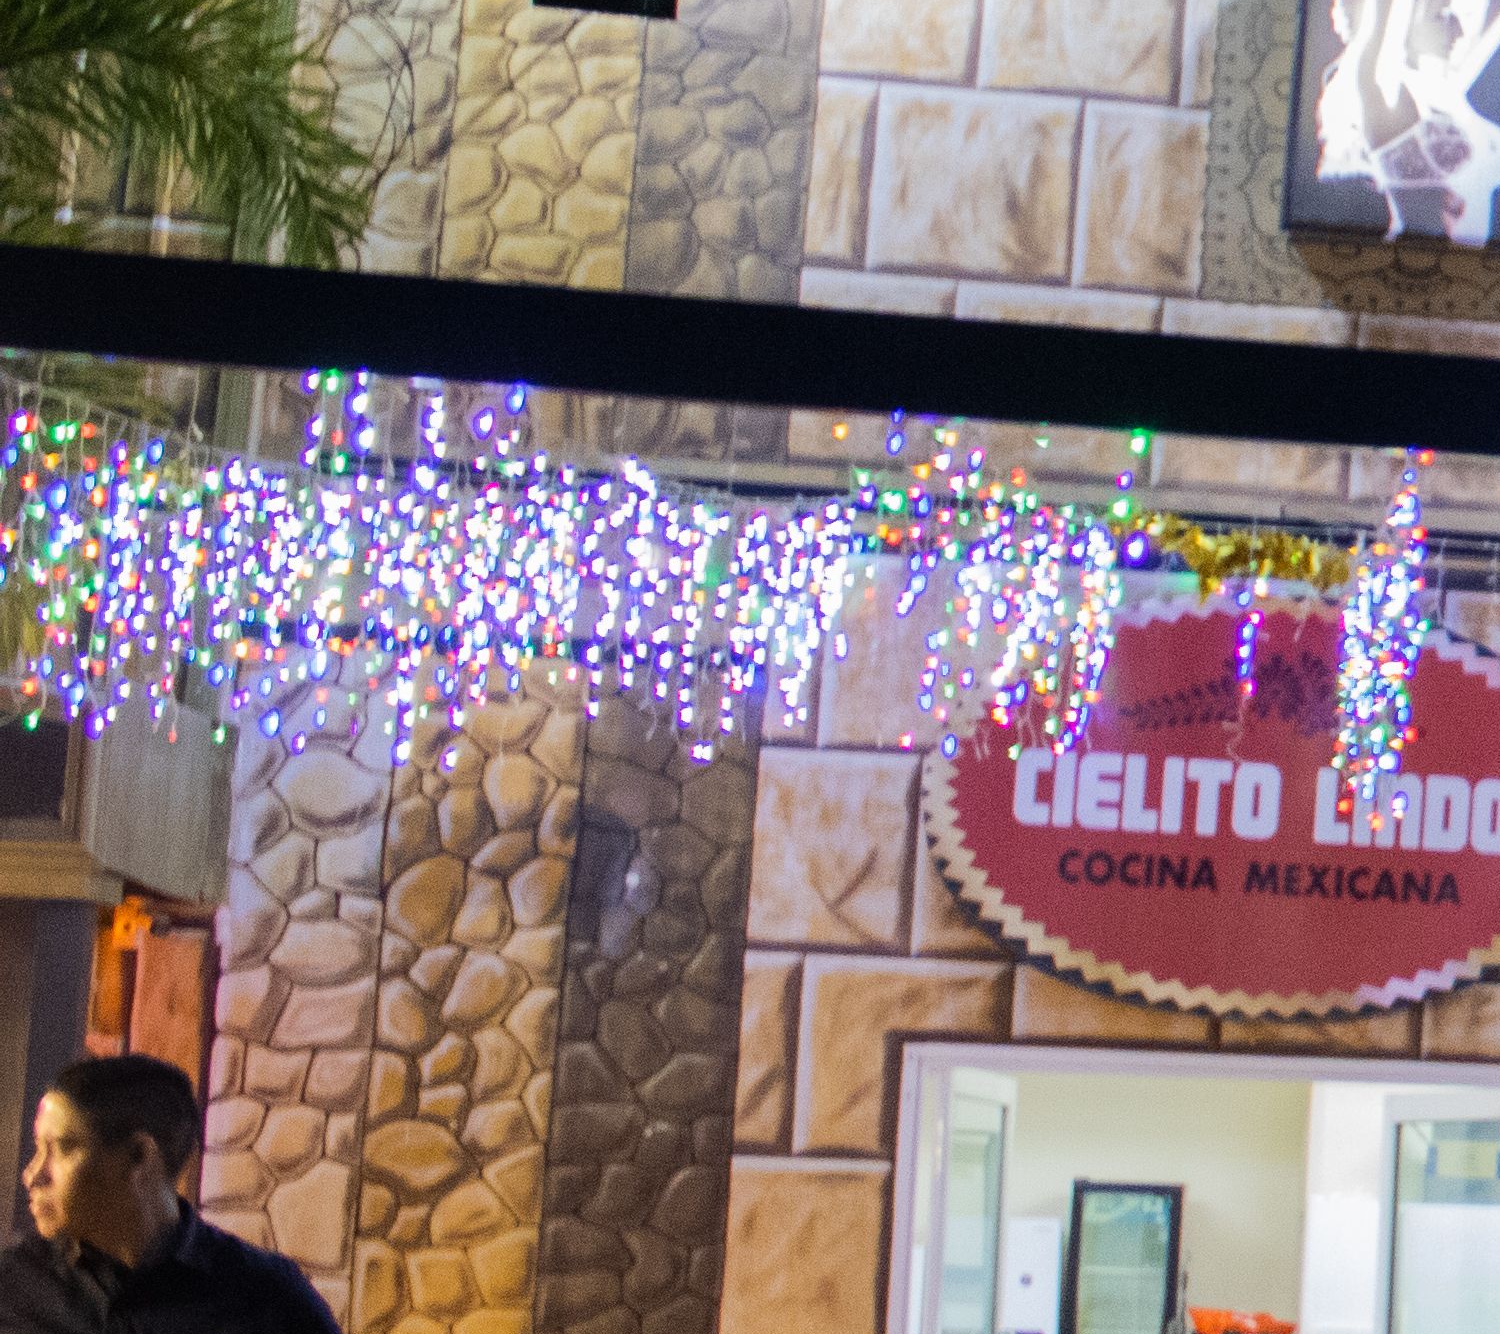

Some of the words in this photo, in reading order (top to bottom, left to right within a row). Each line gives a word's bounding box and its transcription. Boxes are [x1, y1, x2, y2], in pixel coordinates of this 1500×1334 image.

[1012, 746, 1282, 841] CIELITO
[1057, 848, 1218, 892] COCINA
[1243, 861, 1461, 906] MEXICANA
